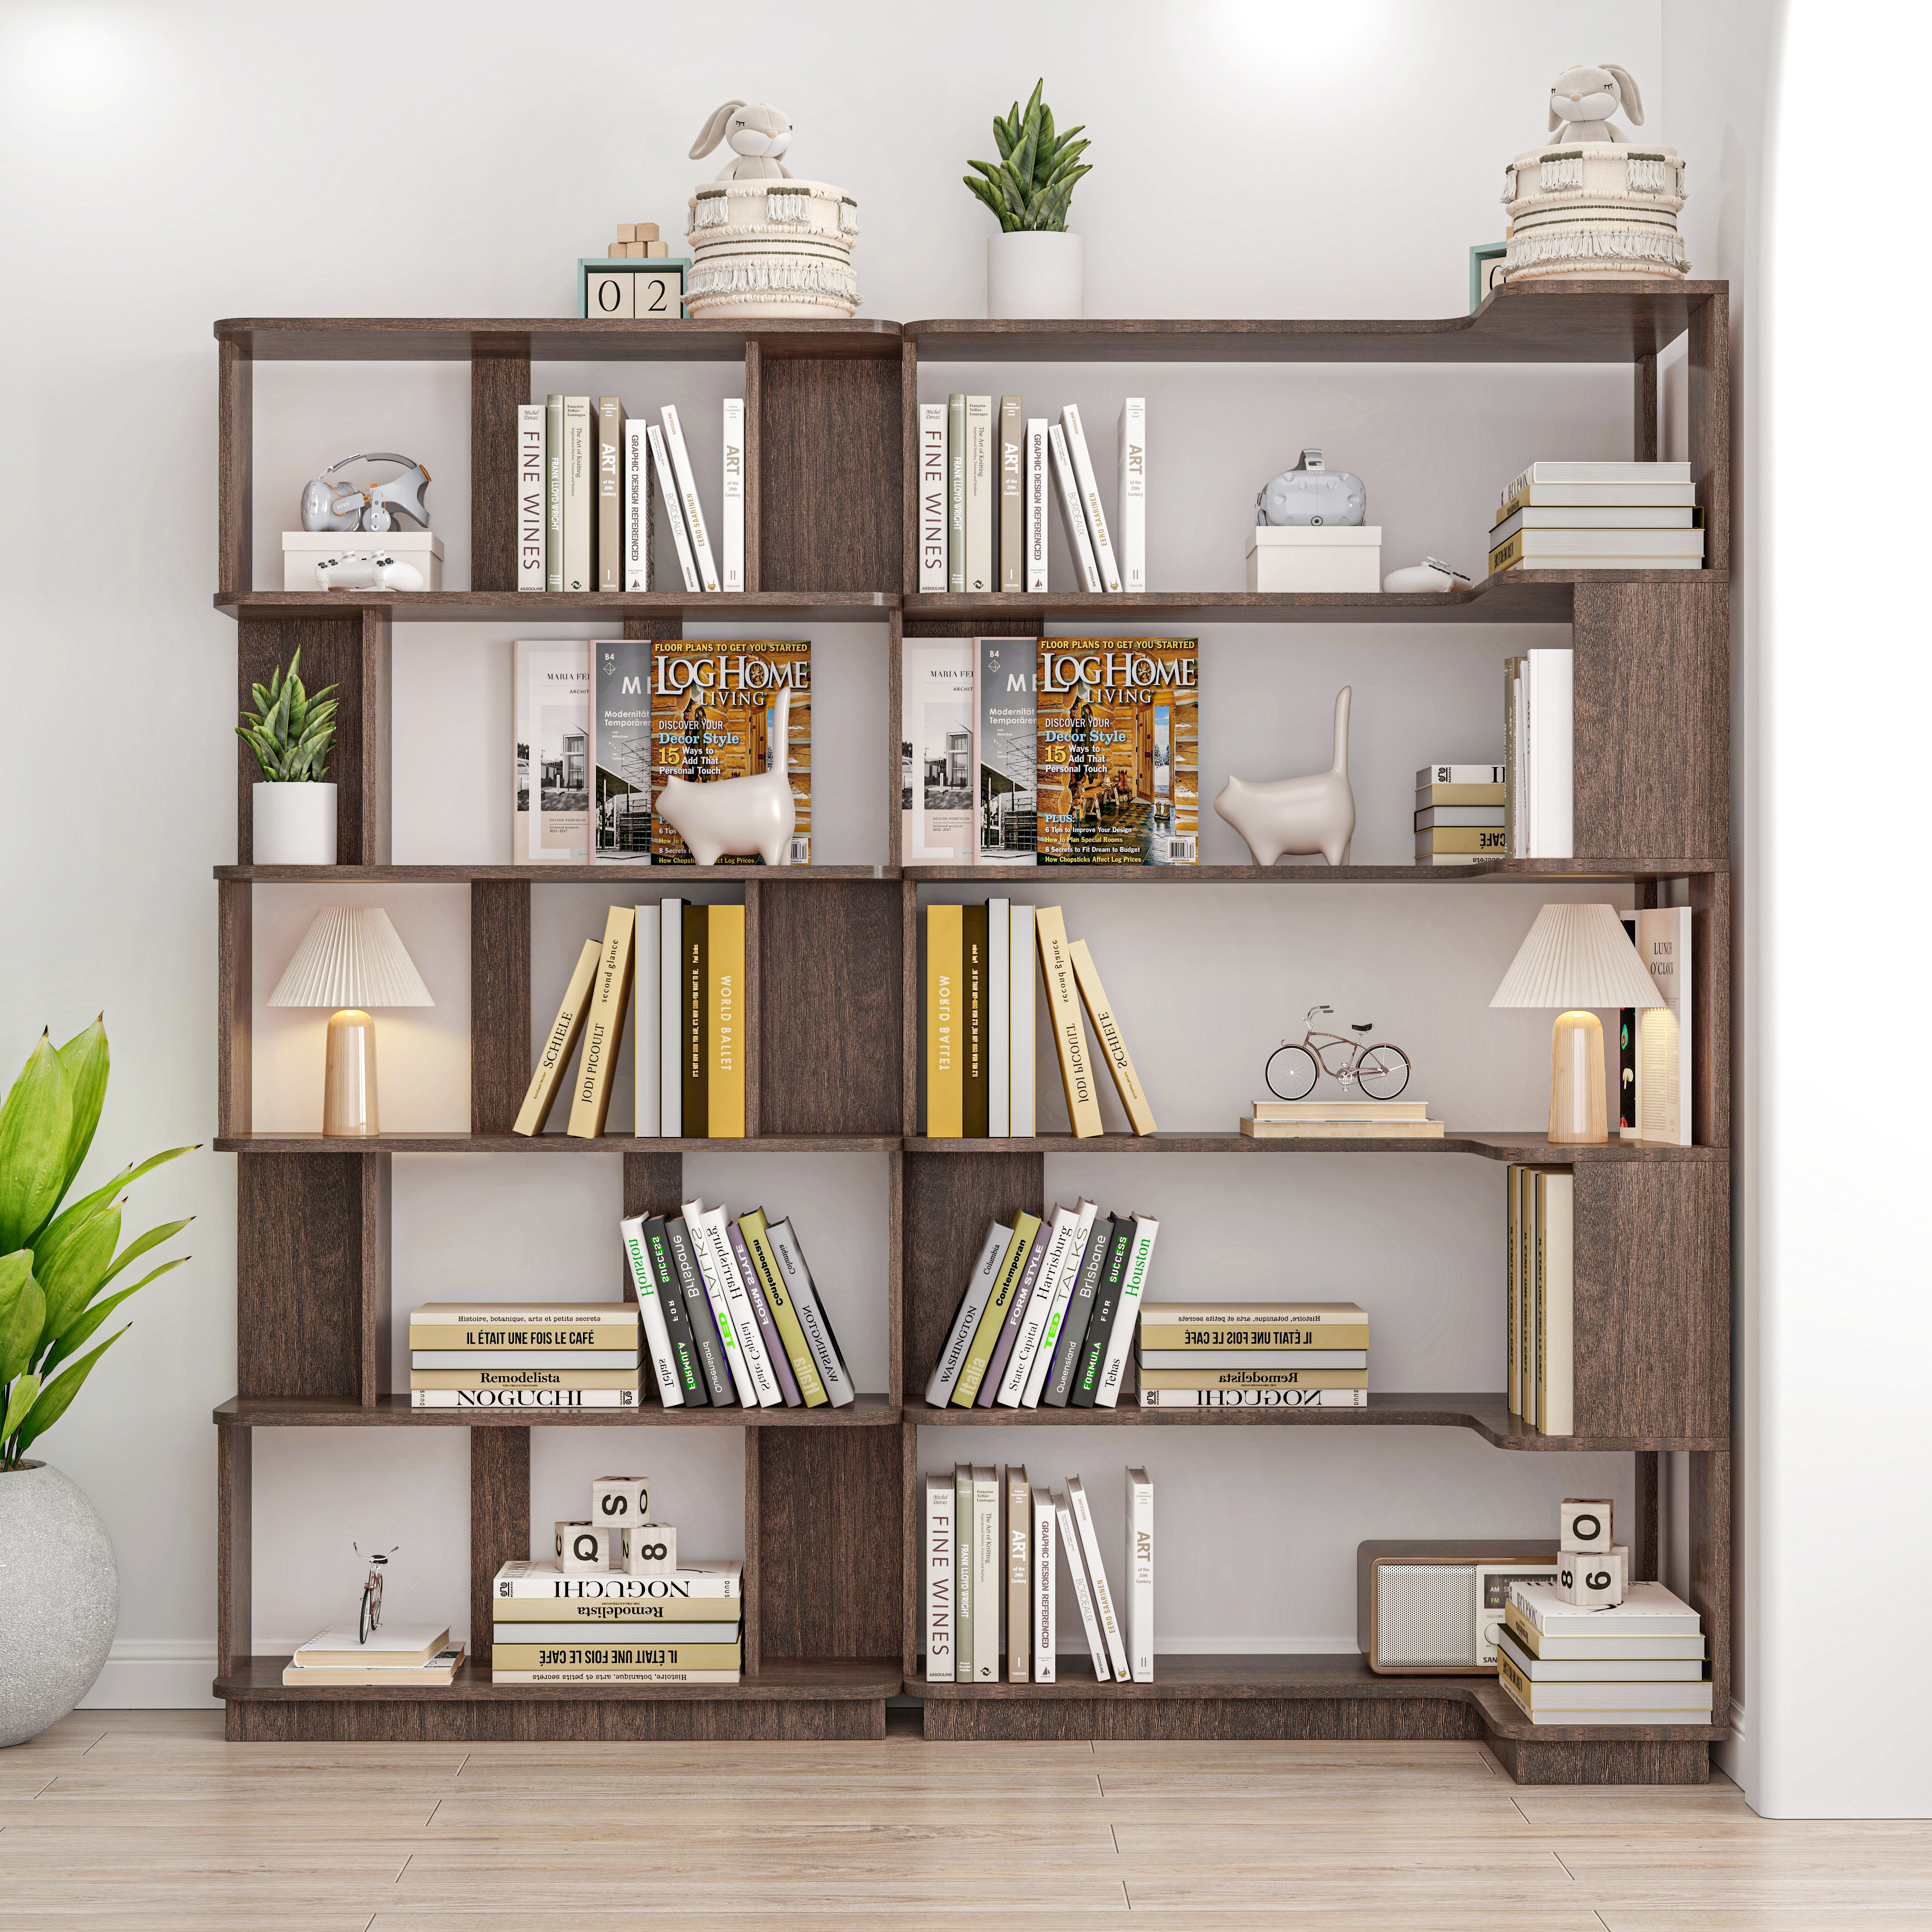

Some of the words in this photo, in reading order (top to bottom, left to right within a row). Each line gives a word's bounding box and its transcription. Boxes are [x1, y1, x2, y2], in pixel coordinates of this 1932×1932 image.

[668, 412, 676, 435] ASSOULINE
[524, 432, 540, 481] FINE
[602, 443, 615, 474] ART
[727, 445, 739, 475] ART
[925, 431, 941, 481] FINE
[666, 493, 683, 537] BORDEAUX
[686, 493, 699, 527] SAARINEN
[524, 494, 540, 569] WINES
[694, 529, 705, 547] EERO
[925, 493, 941, 568] WINES
[686, 567, 694, 588] ASSOULINE
[1045, 719, 1085, 727] DISCOVER
[1088, 719, 1109, 727] YOUR
[1045, 731, 1086, 742] Decor
[1090, 730, 1125, 745] Style
[659, 733, 699, 744] Decor
[703, 732, 739, 747] Style
[1045, 745, 1066, 762] 15
[1068, 744, 1090, 753] Ways
[1046, 765, 1081, 773] Personal
[1084, 765, 1107, 773] Touch
[1068, 754, 1084, 763] Add
[1087, 754, 1105, 763] That
[1654, 942, 1672, 954] LUNCH
[602, 972, 612, 1003] second
[609, 940, 618, 969] glance
[1650, 962, 1674, 975] O'CLOCK
[721, 976, 732, 1021] WORLD
[544, 1012, 572, 1069] SCHIELE
[587, 1023, 604, 1074] PICOULT
[721, 1027, 732, 1070] BALLET
[582, 1076, 595, 1103] JODI
[983, 1245, 1000, 1275] Columbia
[996, 1239, 1026, 1307] Contemporan
[1037, 1225, 1073, 1300] Harrisburg
[1080, 1235, 1106, 1298] Brisbane
[1125, 1239, 1151, 1297] Houston
[1010, 1289, 1028, 1325] FORM
[1024, 1244, 1043, 1285] STYLE
[1044, 1313, 1061, 1349] TED
[1057, 1228, 1087, 1301] TALKS
[1083, 1343, 1101, 1390] FORMULA
[1101, 1300, 1111, 1321] FOR
[1109, 1236, 1127, 1282] SUCCESS
[467, 1333, 475, 1344] IL
[479, 1330, 505, 1344] ÉTAIT
[509, 1333, 527, 1344] UNE
[531, 1332, 552, 1344] FOIS
[555, 1332, 566, 1344] LE
[569, 1330, 594, 1344] CAFÉ
[941, 1306, 977, 1382] WASHINGTON
[1009, 1363, 1025, 1391] State
[1019, 1322, 1038, 1361] Capital
[1057, 1342, 1077, 1393] Queensland
[481, 1372, 560, 1382] Remodelista
[959, 1357, 986, 1396] Italia
[1105, 1359, 1120, 1388] Tehas
[457, 1390, 582, 1406] NOGUCHI
[574, 1534, 598, 1562] Q
[933, 1517, 949, 1566] FINE
[554, 1581, 690, 1597] NOGUCHI
[577, 1606, 664, 1618] Remodelista
[933, 1579, 949, 1655] WINES
[540, 1650, 566, 1666] CAFÉ
[569, 1650, 581, 1663] LE
[585, 1650, 608, 1663] FOIS
[611, 1650, 632, 1663] UNE
[636, 1650, 665, 1666] ÉTAIT
[668, 1650, 677, 1663] IL
